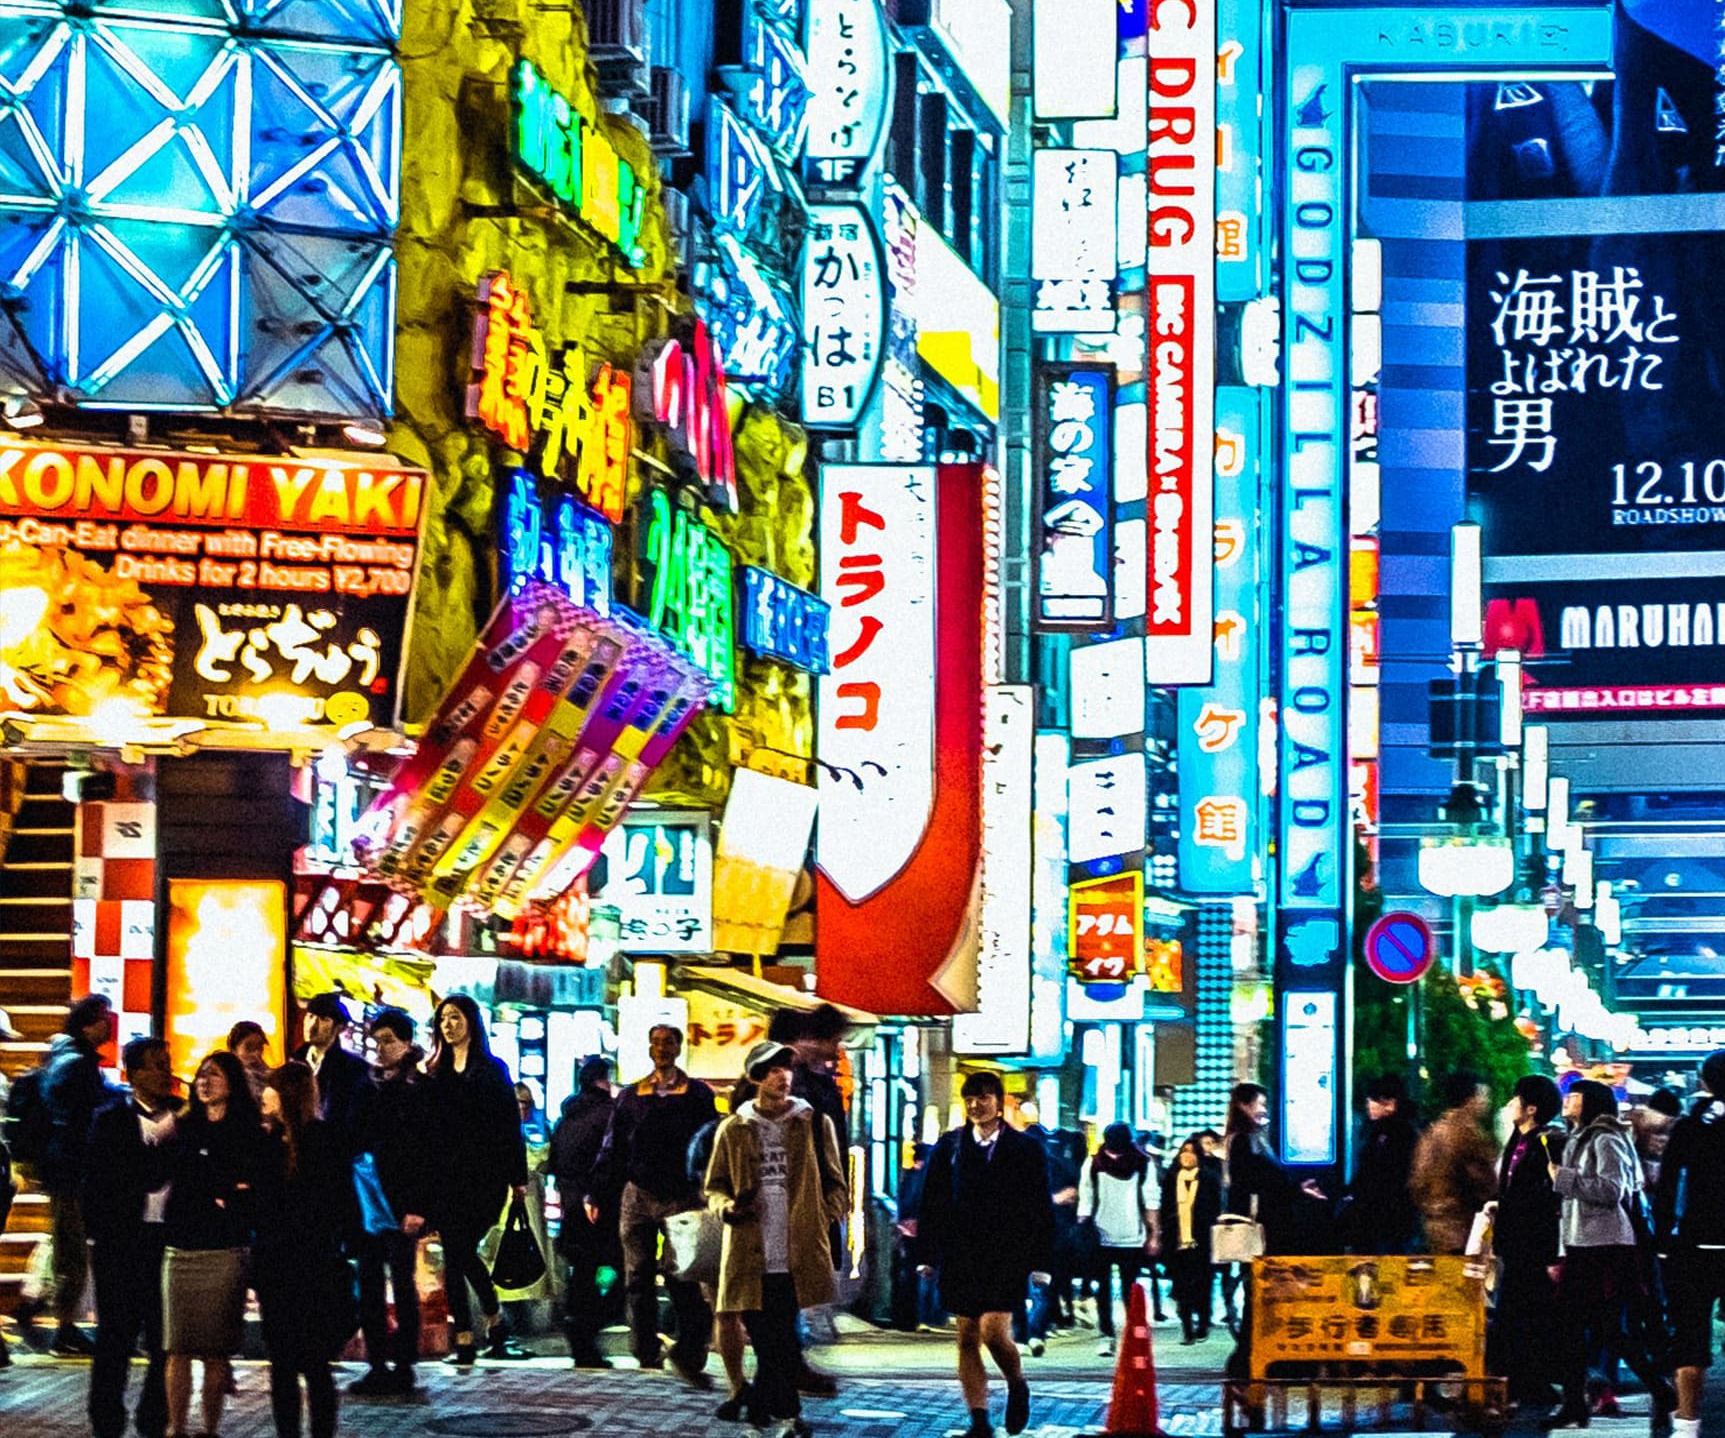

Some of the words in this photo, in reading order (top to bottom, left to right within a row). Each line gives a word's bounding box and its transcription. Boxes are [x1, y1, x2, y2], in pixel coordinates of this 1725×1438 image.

[816, 159, 856, 182] 1F
[1149, 56, 1197, 248] DRUG
[1489, 266, 1680, 346] 海賊と
[1294, 147, 1334, 570] GODZILLA
[1489, 346, 1664, 395] よばれた
[817, 384, 855, 409] B1
[1488, 397, 1559, 474] 男
[267, 466, 422, 529] YAKI
[114, 554, 195, 585] Drinks
[198, 558, 236, 587] for
[237, 562, 258, 588] 2
[258, 563, 330, 593] hours
[120, 523, 202, 556] dinner
[204, 528, 258, 557] with
[258, 530, 415, 569] Free-Flowing
[833, 490, 887, 732] トラノコ
[1292, 628, 1332, 828] ROAD
